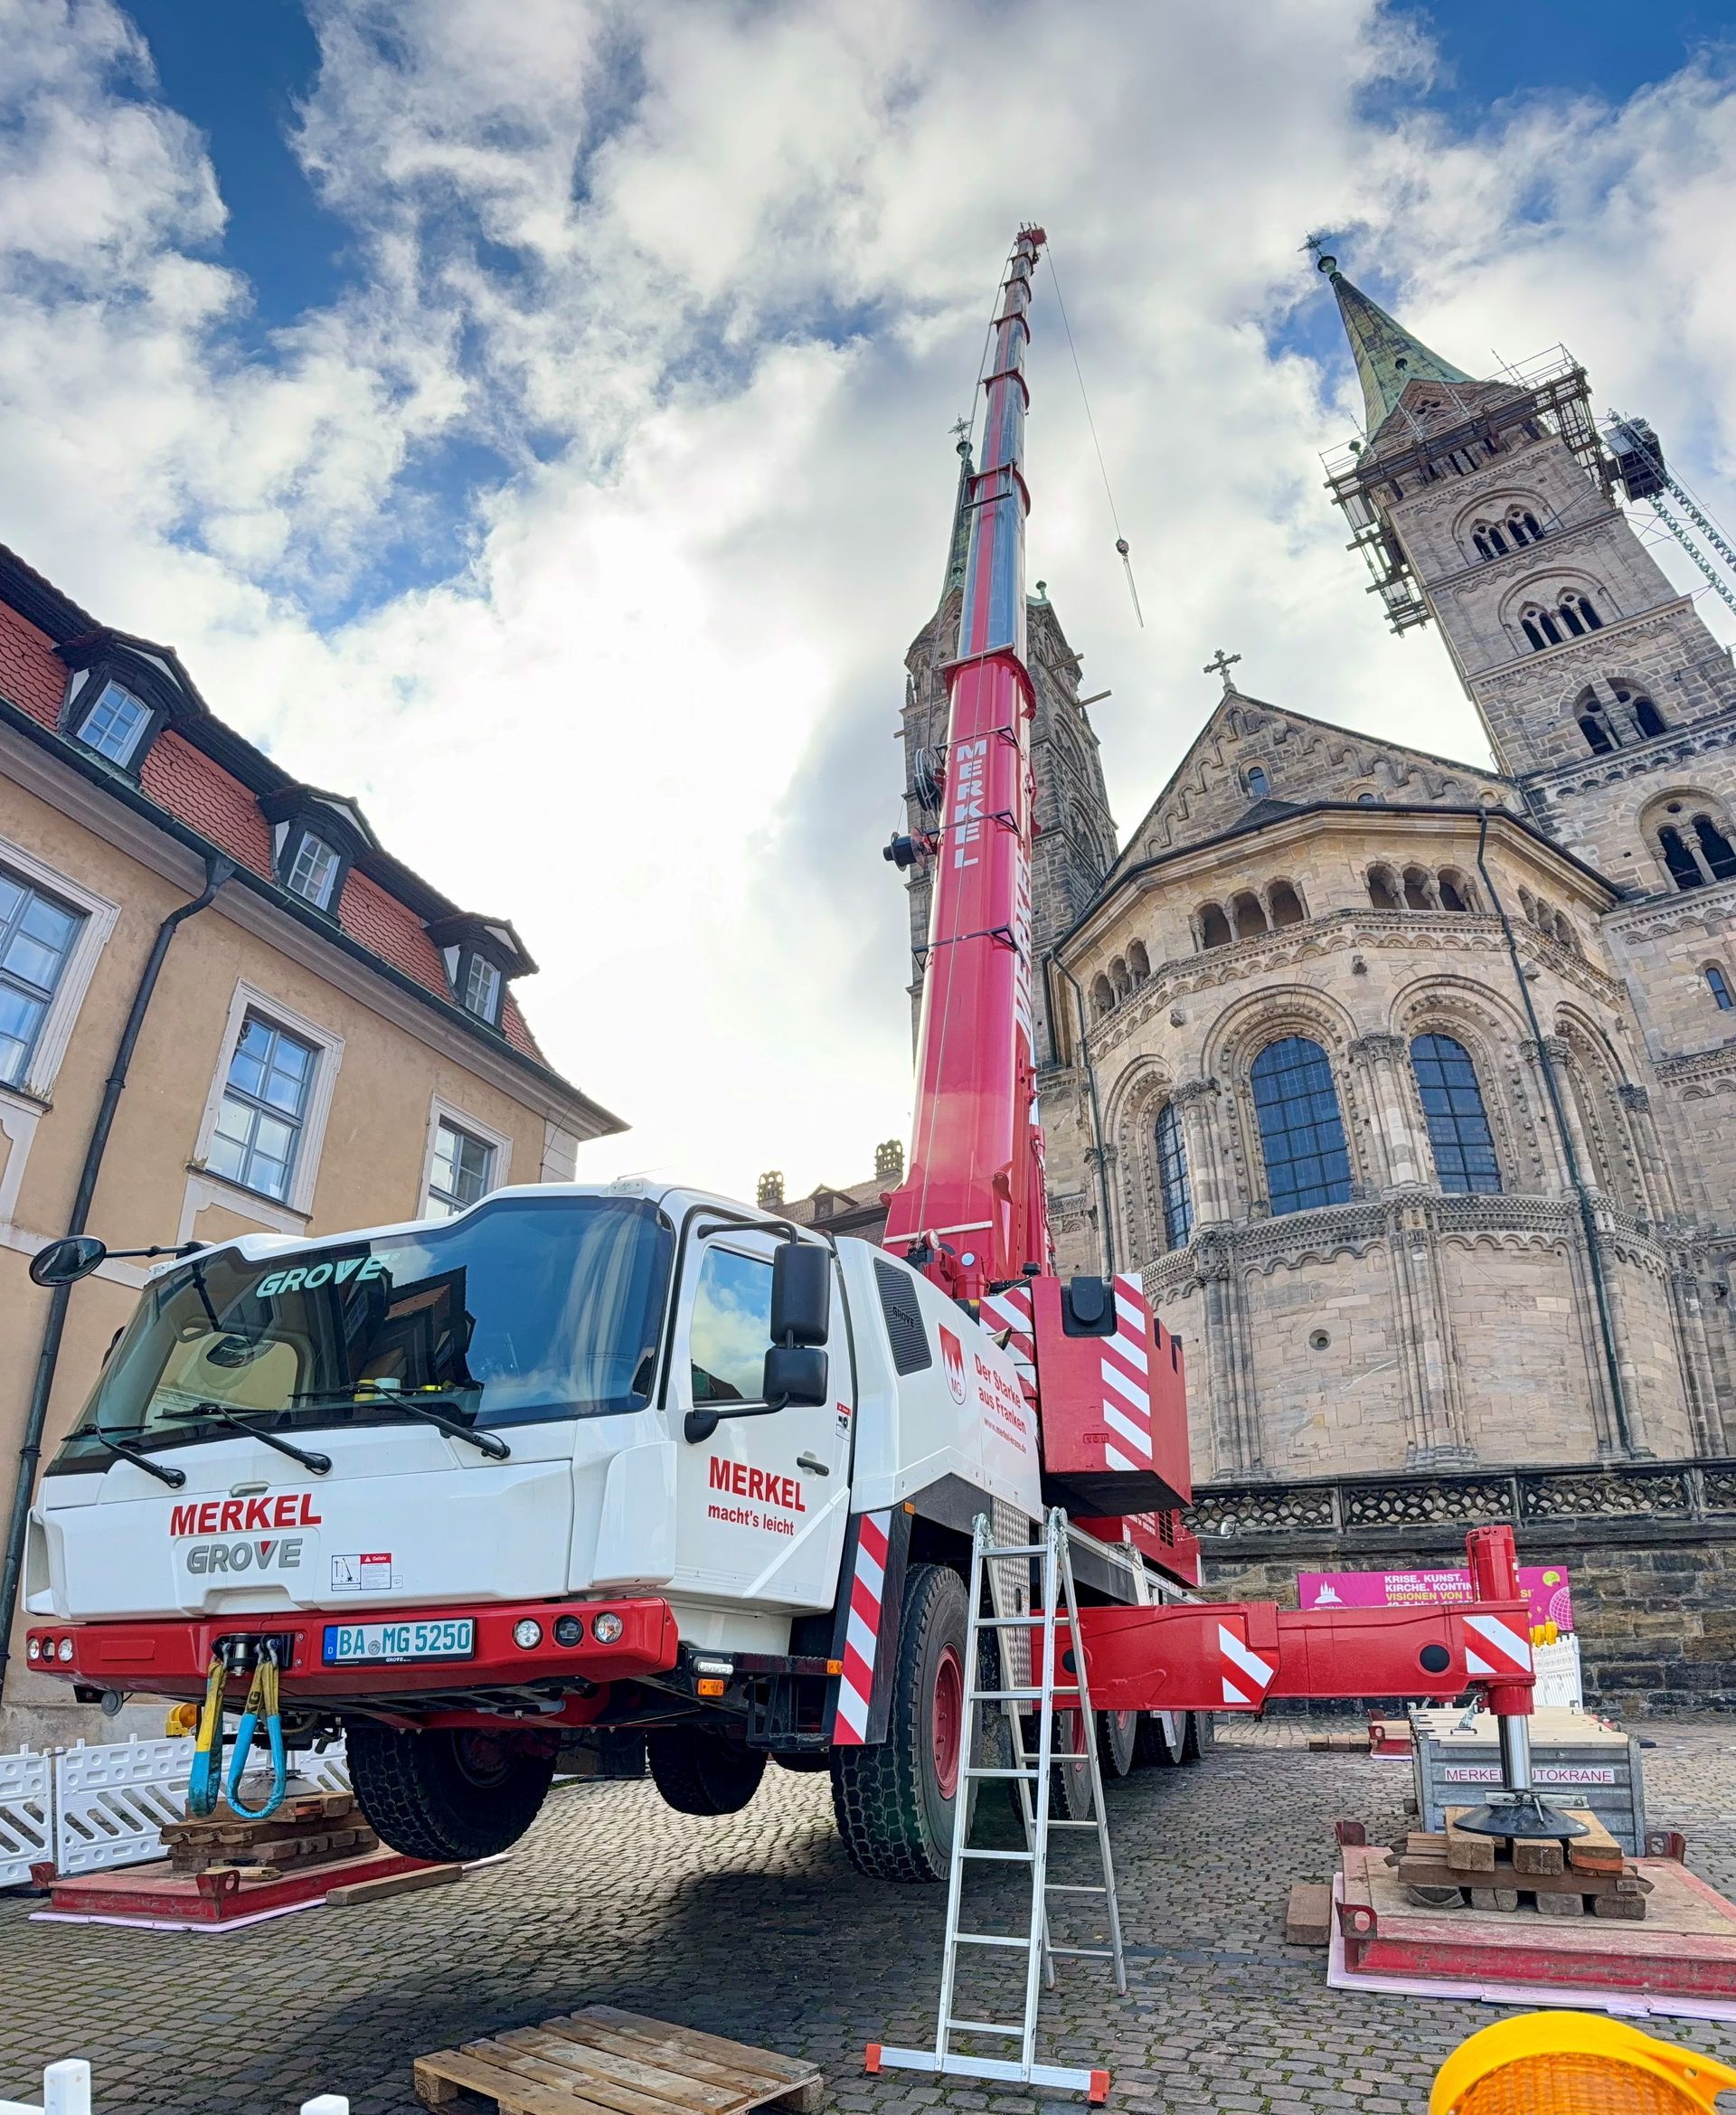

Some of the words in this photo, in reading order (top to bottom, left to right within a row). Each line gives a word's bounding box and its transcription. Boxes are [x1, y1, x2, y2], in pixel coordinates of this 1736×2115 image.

[954, 739, 987, 869] MERKEL
[892, 1306, 915, 1328] GROVE
[974, 1352, 991, 1383] Der
[993, 1369, 1021, 1409] Starke
[978, 1386, 995, 1411] aus
[995, 1395, 1027, 1435] Franken
[709, 1456, 806, 1512] MERKEL
[170, 1493, 322, 1536] MERKEL
[707, 1504, 760, 1528] macht's
[763, 1514, 795, 1536] leicht
[186, 1537, 304, 1574] GROVE
[1384, 1574, 1420, 1583] KRISE.
[1424, 1573, 1464, 1582] KUNST.
[1384, 1583, 1429, 1592] KIRCHE.
[1433, 1582, 1472, 1591] KONTIN
[1385, 1591, 1438, 1601] VISIONEN
[1440, 1591, 1463, 1600] VON
[339, 1629, 365, 1656] BA
[382, 1627, 410, 1654] MG
[415, 1623, 470, 1652] 5250
